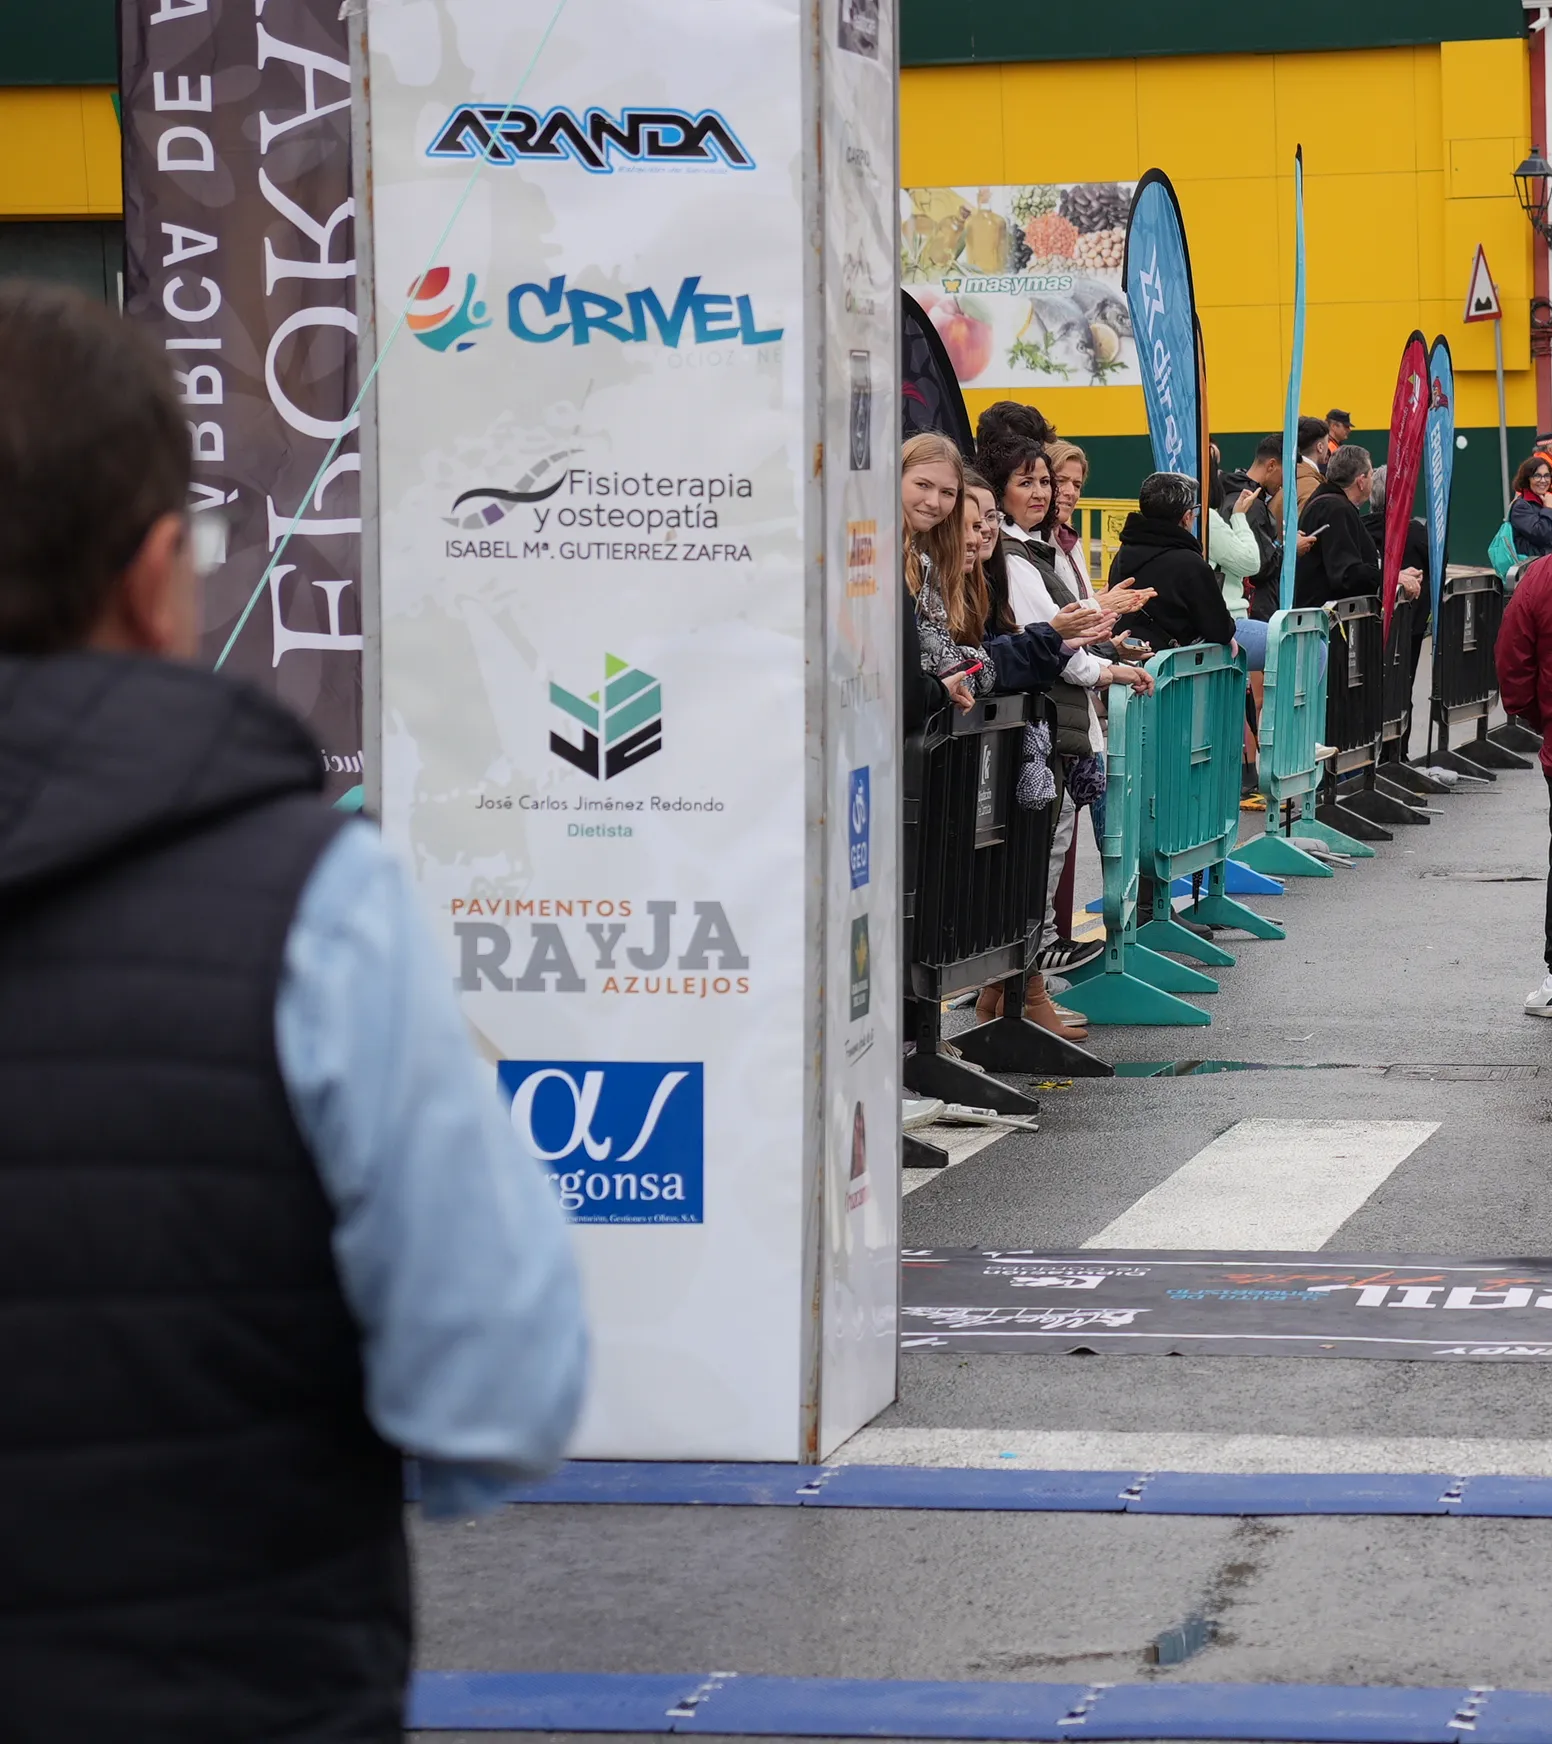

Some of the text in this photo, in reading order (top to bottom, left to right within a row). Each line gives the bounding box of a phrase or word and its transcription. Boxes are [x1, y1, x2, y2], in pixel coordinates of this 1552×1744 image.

[427, 104, 755, 173] ARANDA
[965, 275, 1073, 296] masymas
[508, 274, 784, 349] CRIVEL
[569, 469, 753, 501] Fisioterapia
[533, 503, 719, 534] y osteopatía
[446, 541, 518, 558] ISABEL
[560, 543, 677, 561] GUTIERREZ
[682, 545, 753, 562] ZAFRA
[475, 794, 725, 812] José Carlos Jiménez Redondo
[567, 823, 633, 837] Dietista
[452, 899, 632, 917] PAVIMENTOS
[602, 976, 750, 999] AZULEJOS
[545, 1168, 687, 1211] rgonsa
